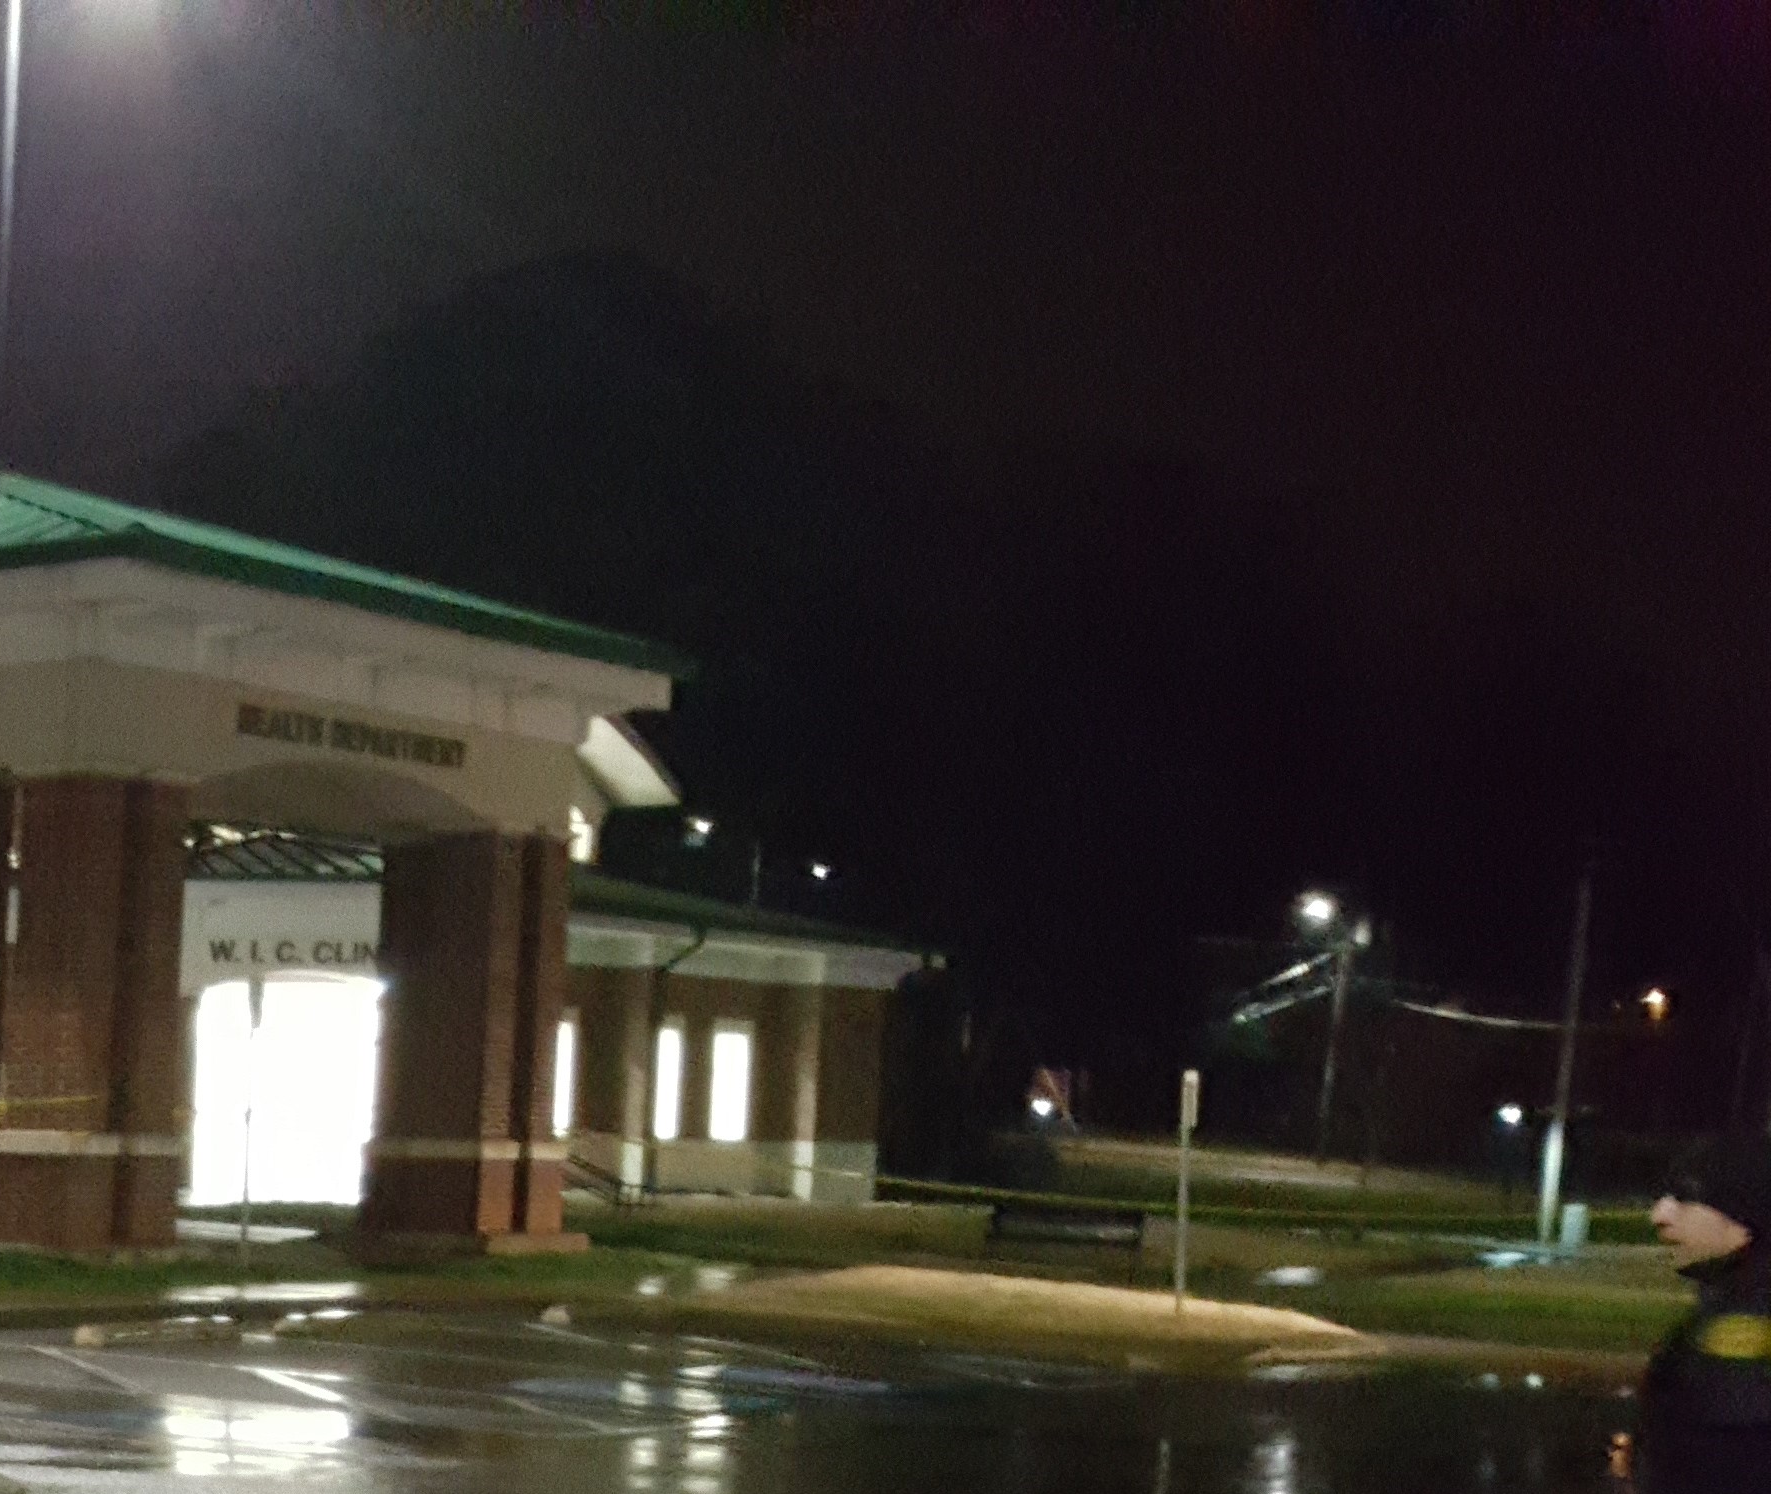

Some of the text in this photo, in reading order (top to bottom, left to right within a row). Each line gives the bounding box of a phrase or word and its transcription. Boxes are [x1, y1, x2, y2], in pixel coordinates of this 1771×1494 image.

[236, 703, 466, 768] HEALTH DEPARTMENT
[209, 939, 242, 963] W.
[312, 940, 377, 963] CLIN
